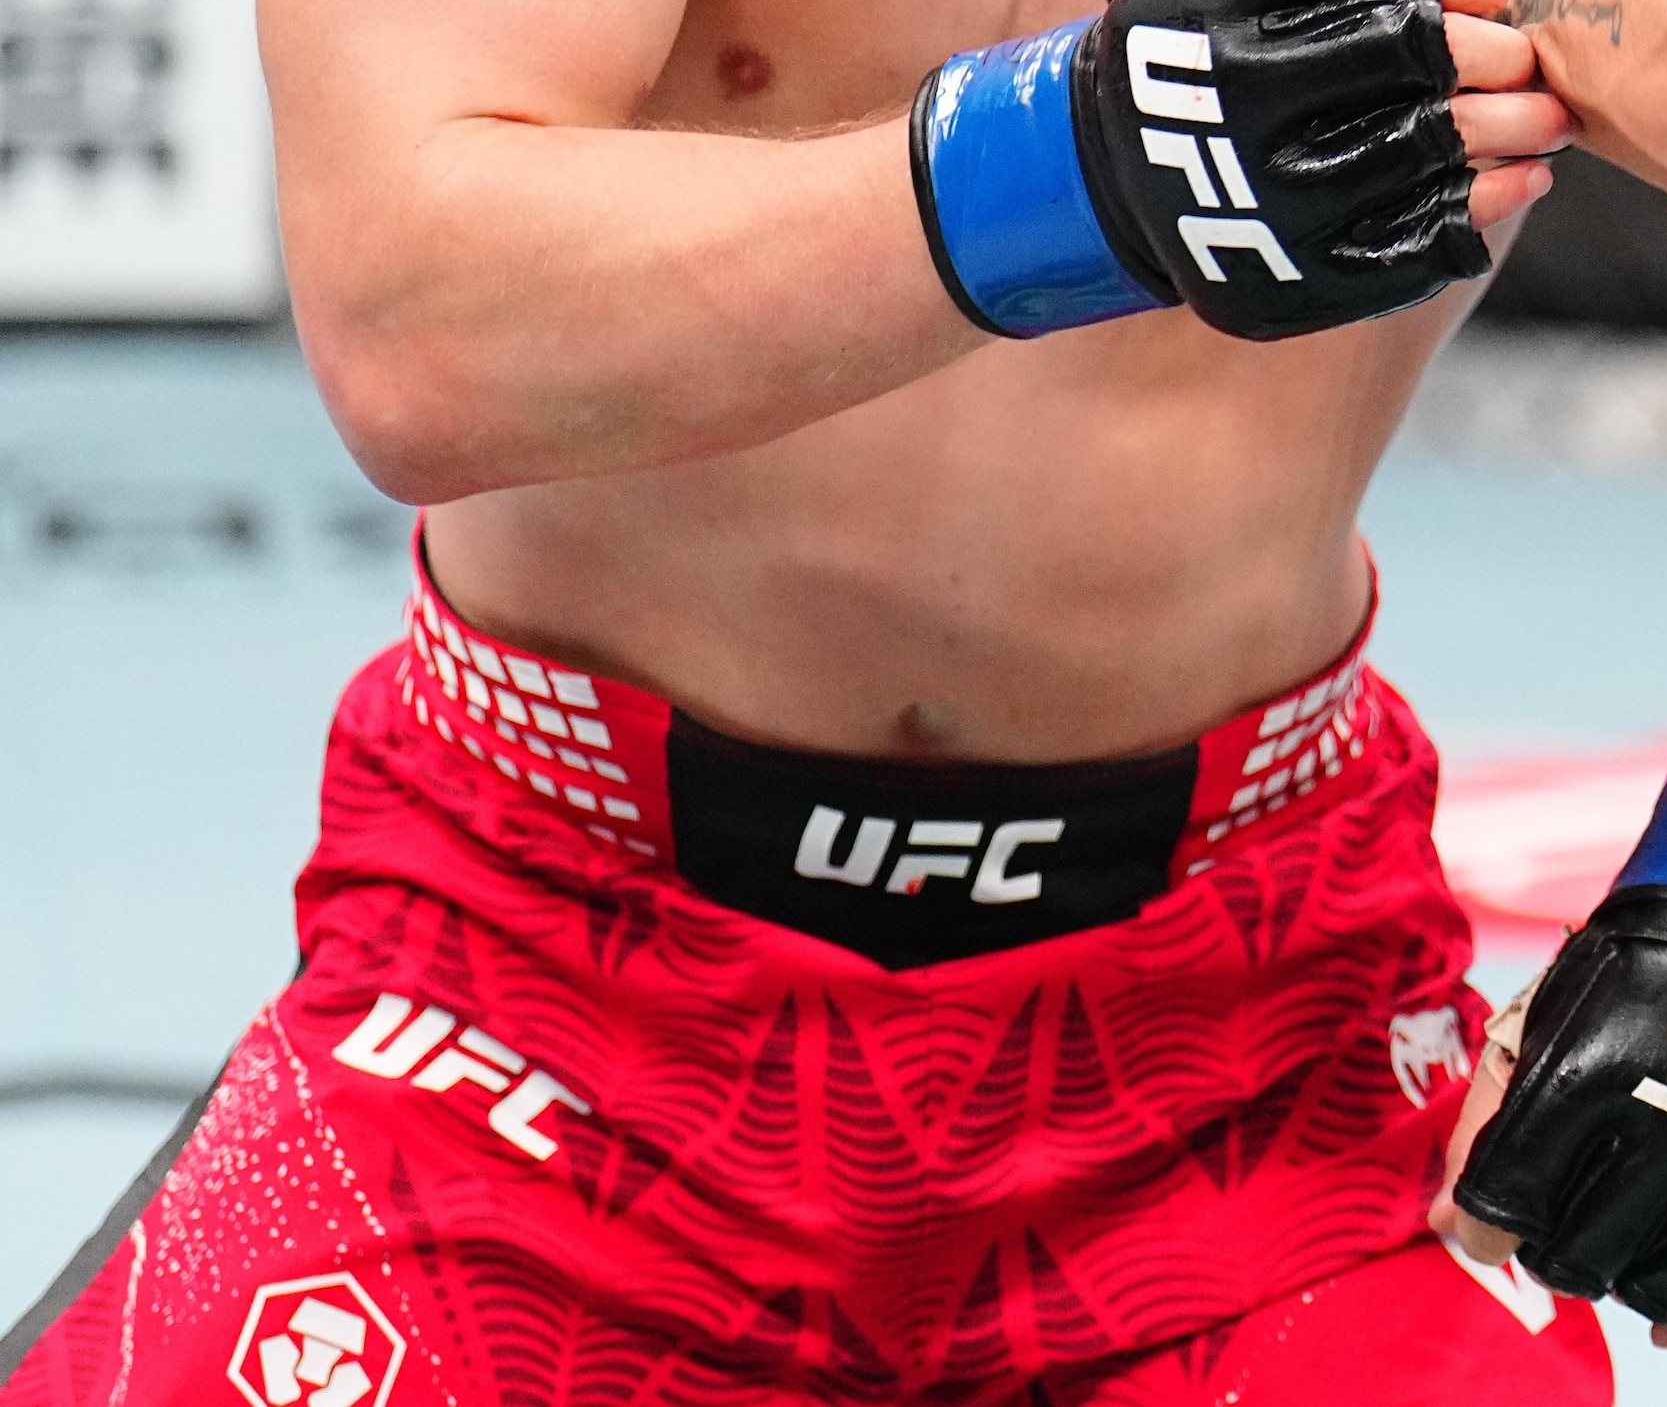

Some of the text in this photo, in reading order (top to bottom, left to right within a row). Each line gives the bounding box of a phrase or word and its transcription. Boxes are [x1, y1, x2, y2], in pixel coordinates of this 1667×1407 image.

[1127, 24, 1303, 283] UFC
[794, 805, 1065, 904] UFC
[332, 993, 591, 1162] UFC
